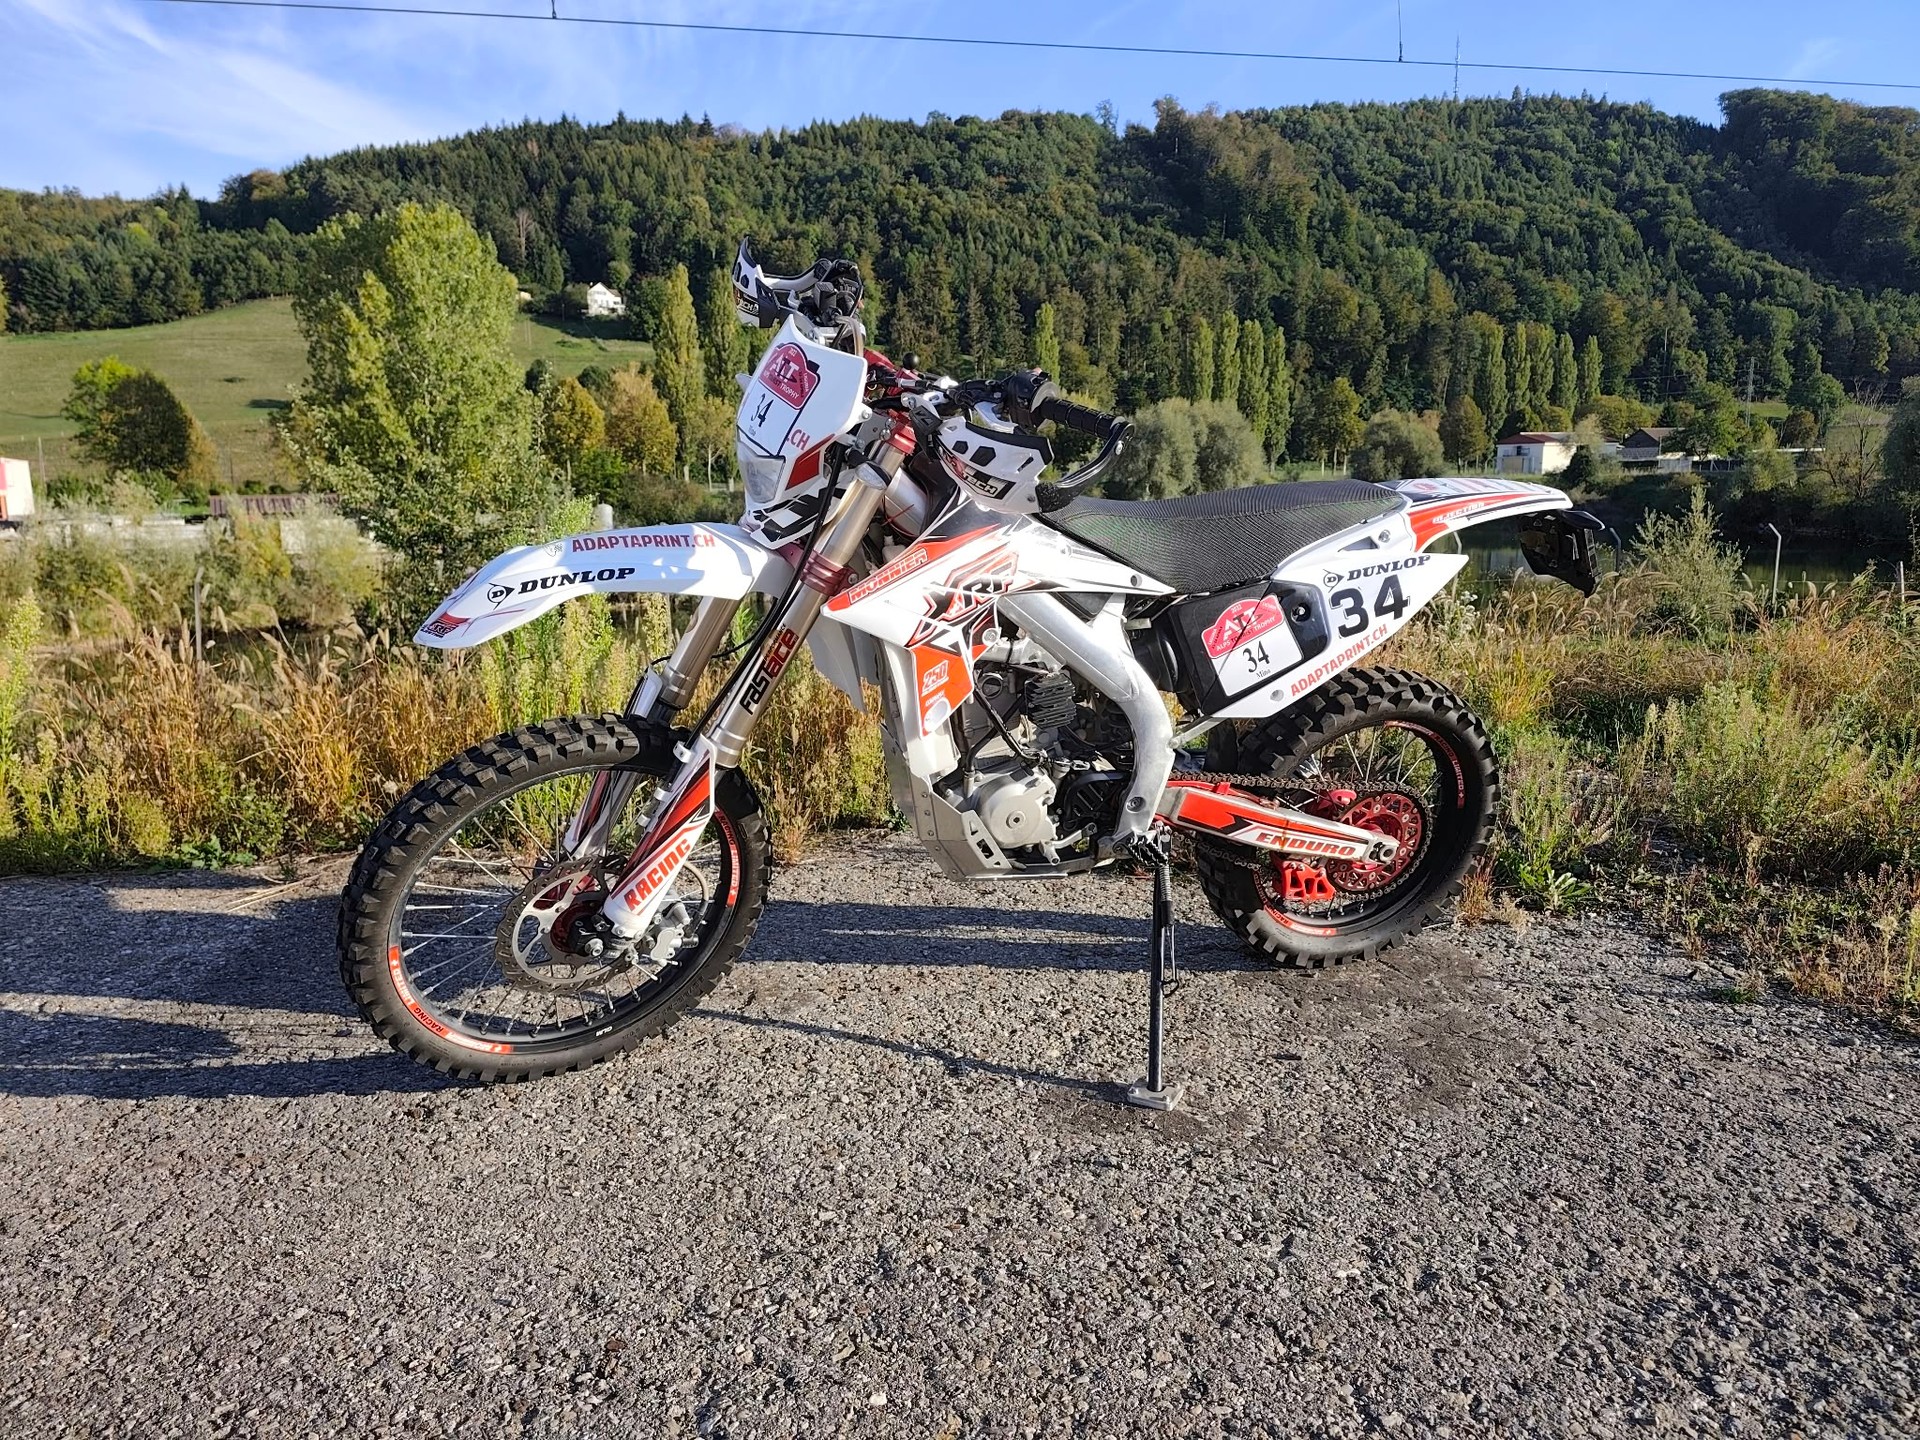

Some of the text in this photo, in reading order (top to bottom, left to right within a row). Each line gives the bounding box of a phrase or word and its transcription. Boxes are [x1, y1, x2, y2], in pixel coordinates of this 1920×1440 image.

[780, 382, 800, 399] TROPHY
[751, 393, 774, 427] 34
[572, 534, 716, 552] ADAPTAPRINT.CH
[518, 567, 636, 594] DUNLOP
[849, 548, 928, 604] MONNIER
[1347, 555, 1431, 581] DUNLOP
[1330, 574, 1409, 638] 34
[1216, 640, 1231, 651] ALPS
[1254, 616, 1276, 631] TROPHY
[1242, 640, 1270, 673] 34
[1291, 624, 1388, 696] ADAPTAPRINT.CH
[923, 660, 949, 690] 250
[1452, 760, 1464, 790] LIMITED
[720, 815, 740, 887] RACING LIMITED
[1256, 832, 1356, 856] ENDURO
[623, 839, 691, 911] RACING
[414, 1007, 444, 1033] RACING
